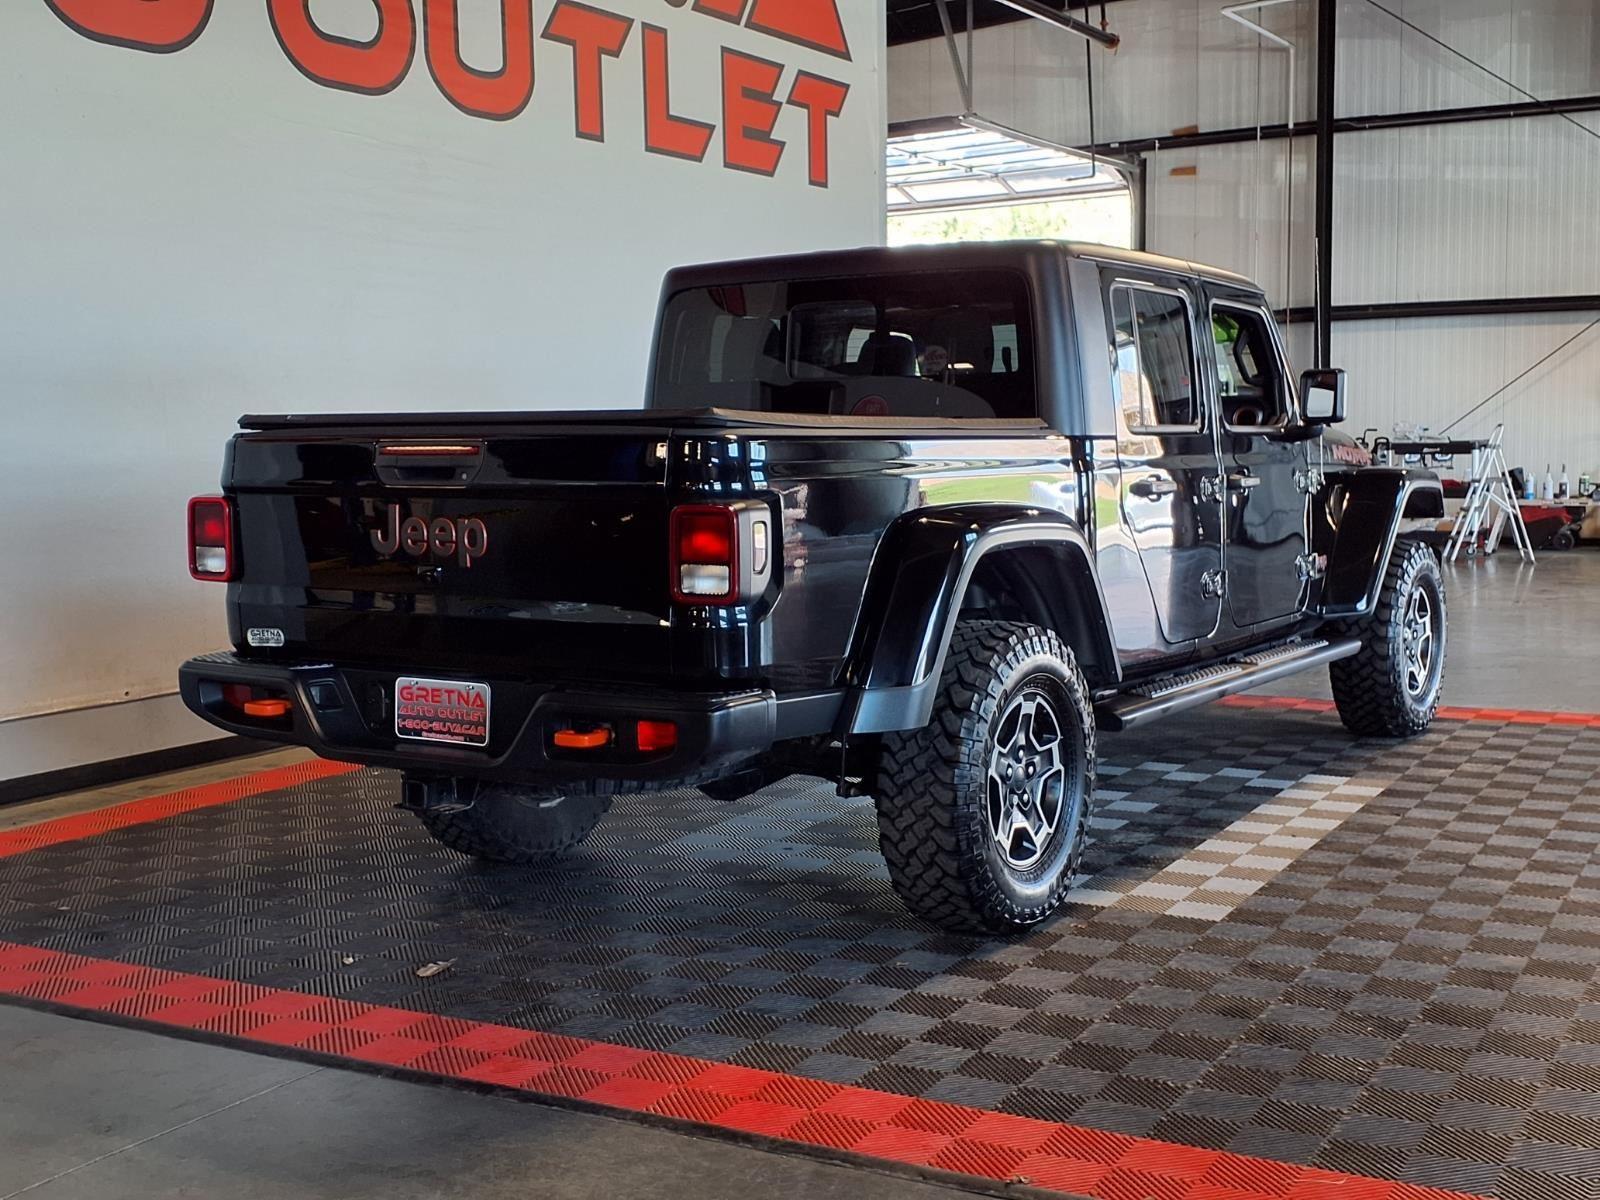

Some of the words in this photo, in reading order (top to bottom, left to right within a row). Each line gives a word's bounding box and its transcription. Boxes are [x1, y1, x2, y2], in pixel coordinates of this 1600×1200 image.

[370, 504, 487, 568] Jeep
[250, 629, 281, 637] GRETNA
[400, 686, 485, 708] GRETNA
[399, 705, 434, 717] AUTO
[438, 707, 486, 722] OUTLET
